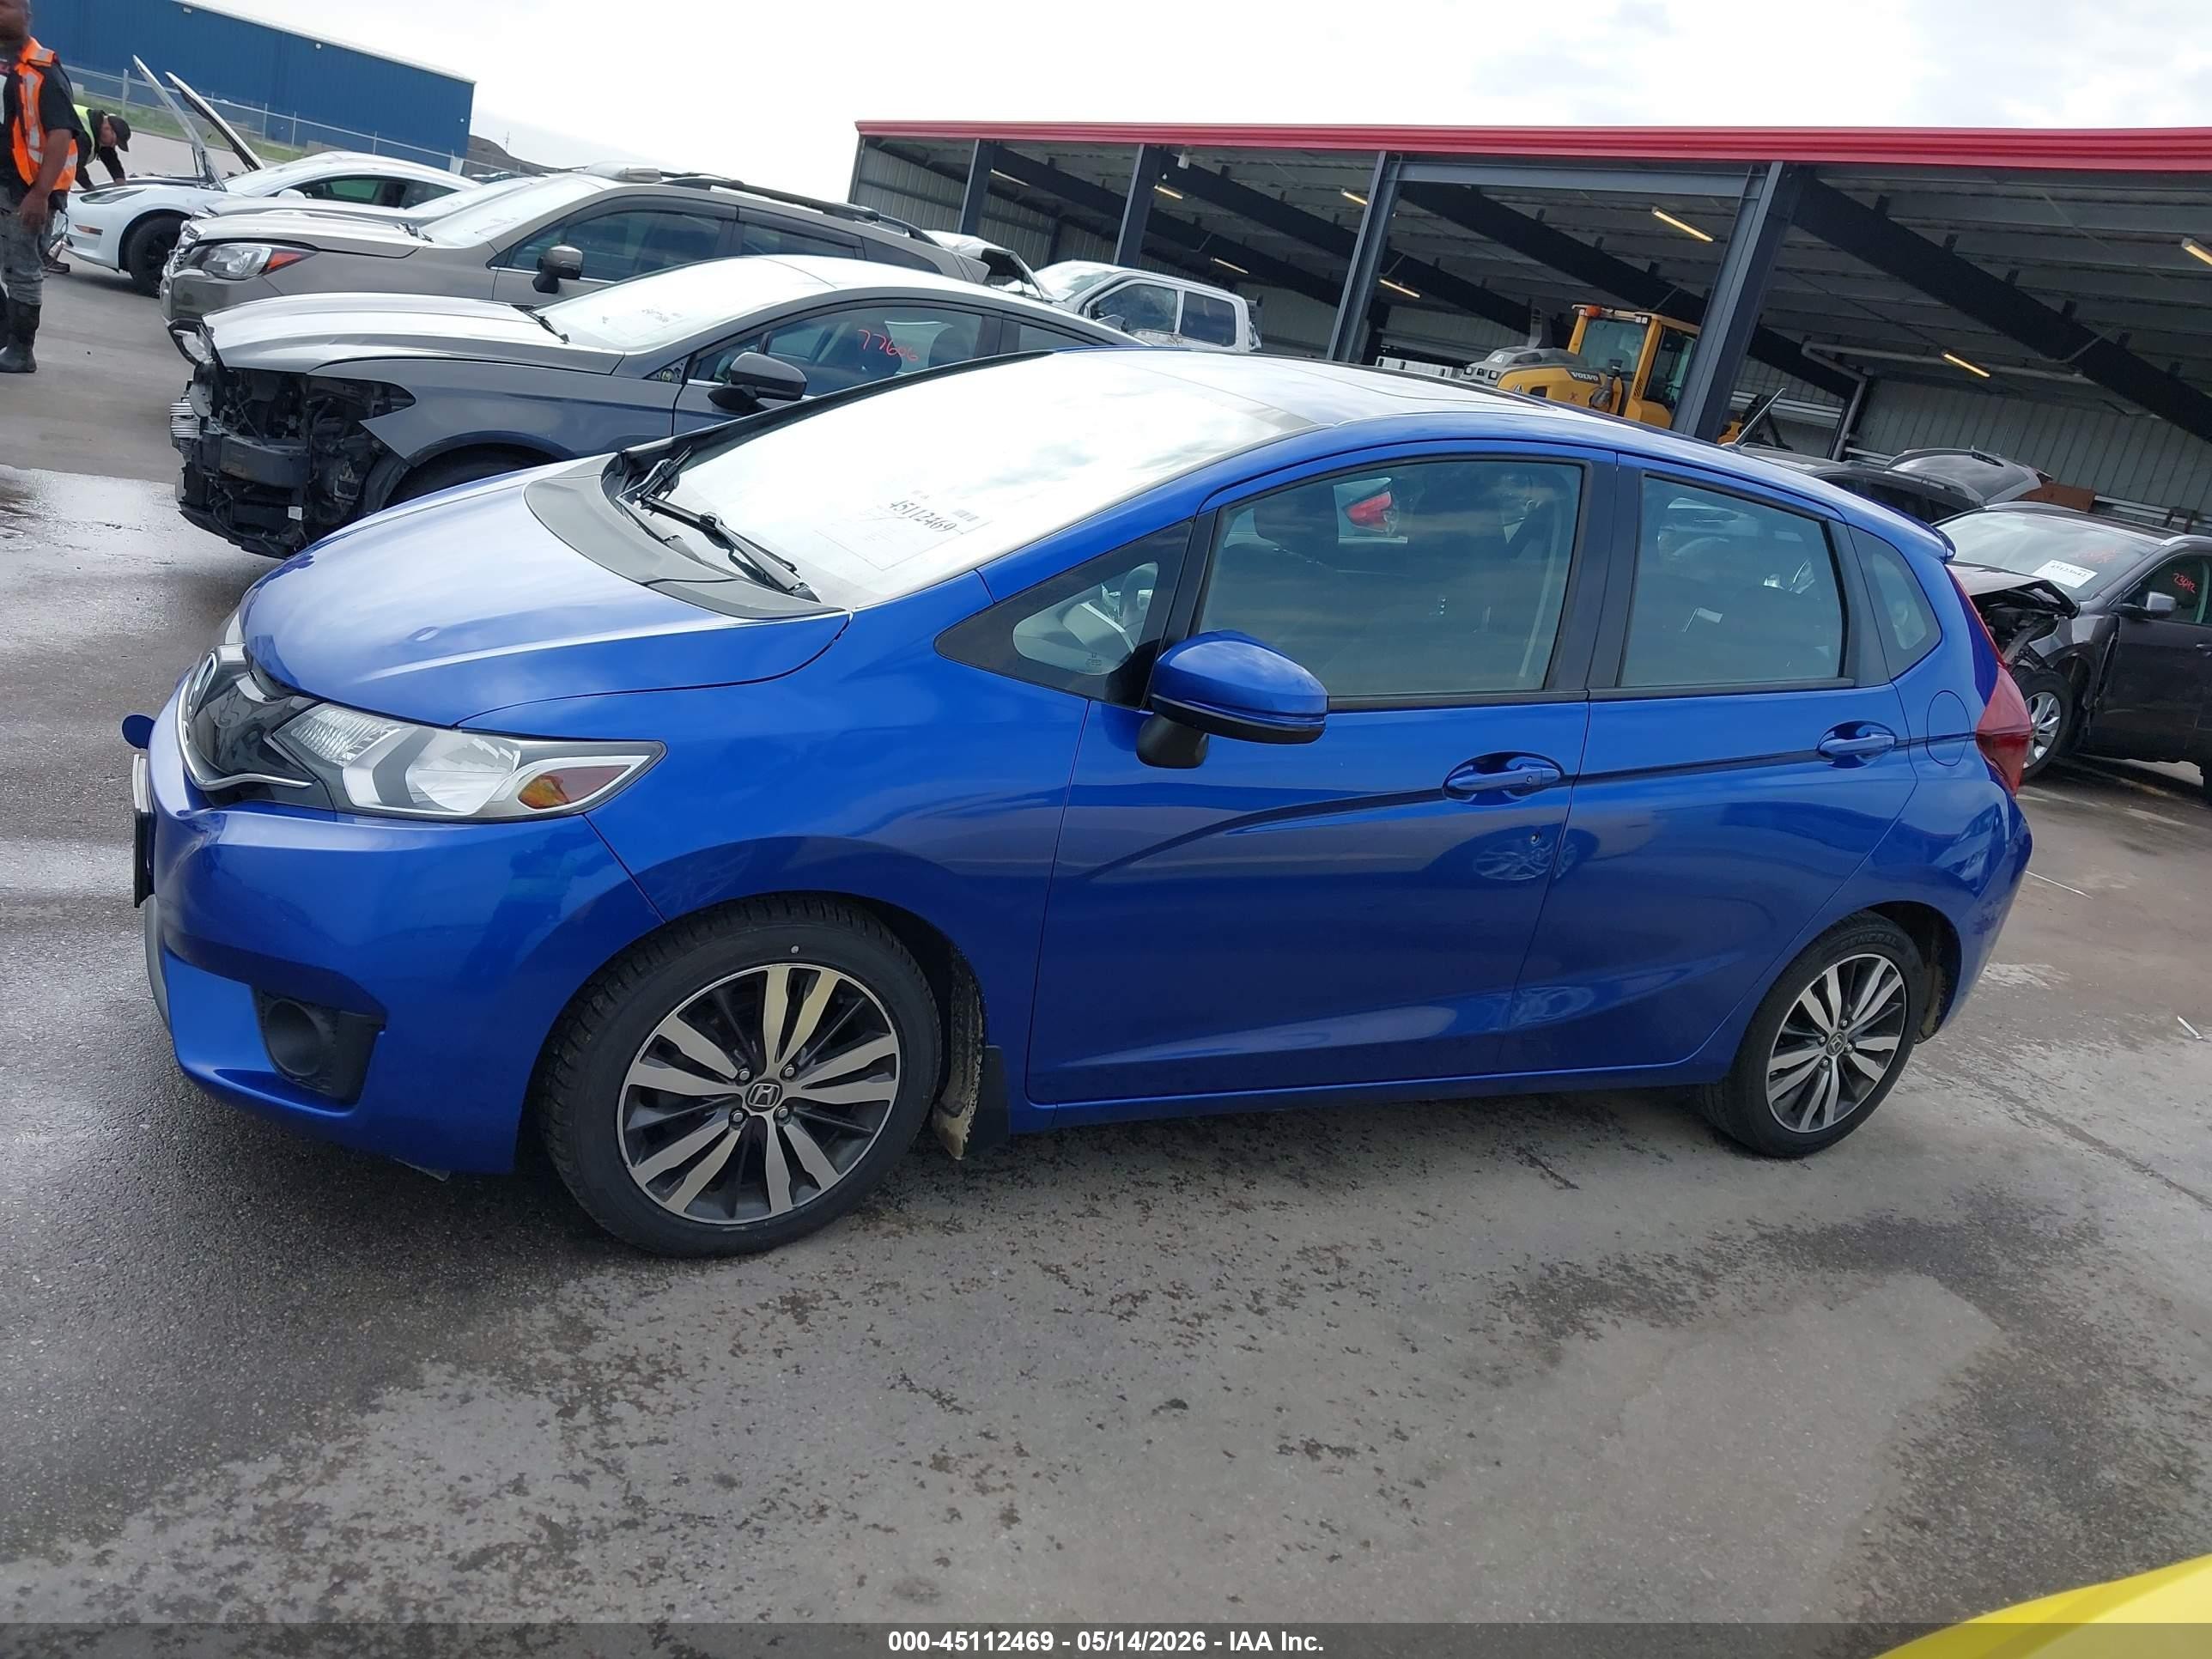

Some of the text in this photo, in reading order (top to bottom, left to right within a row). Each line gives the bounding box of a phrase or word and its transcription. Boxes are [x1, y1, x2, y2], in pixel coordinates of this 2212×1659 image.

[858, 329, 919, 362] 77606
[1571, 371, 1599, 381] VOLVO
[889, 500, 957, 532] 45112469
